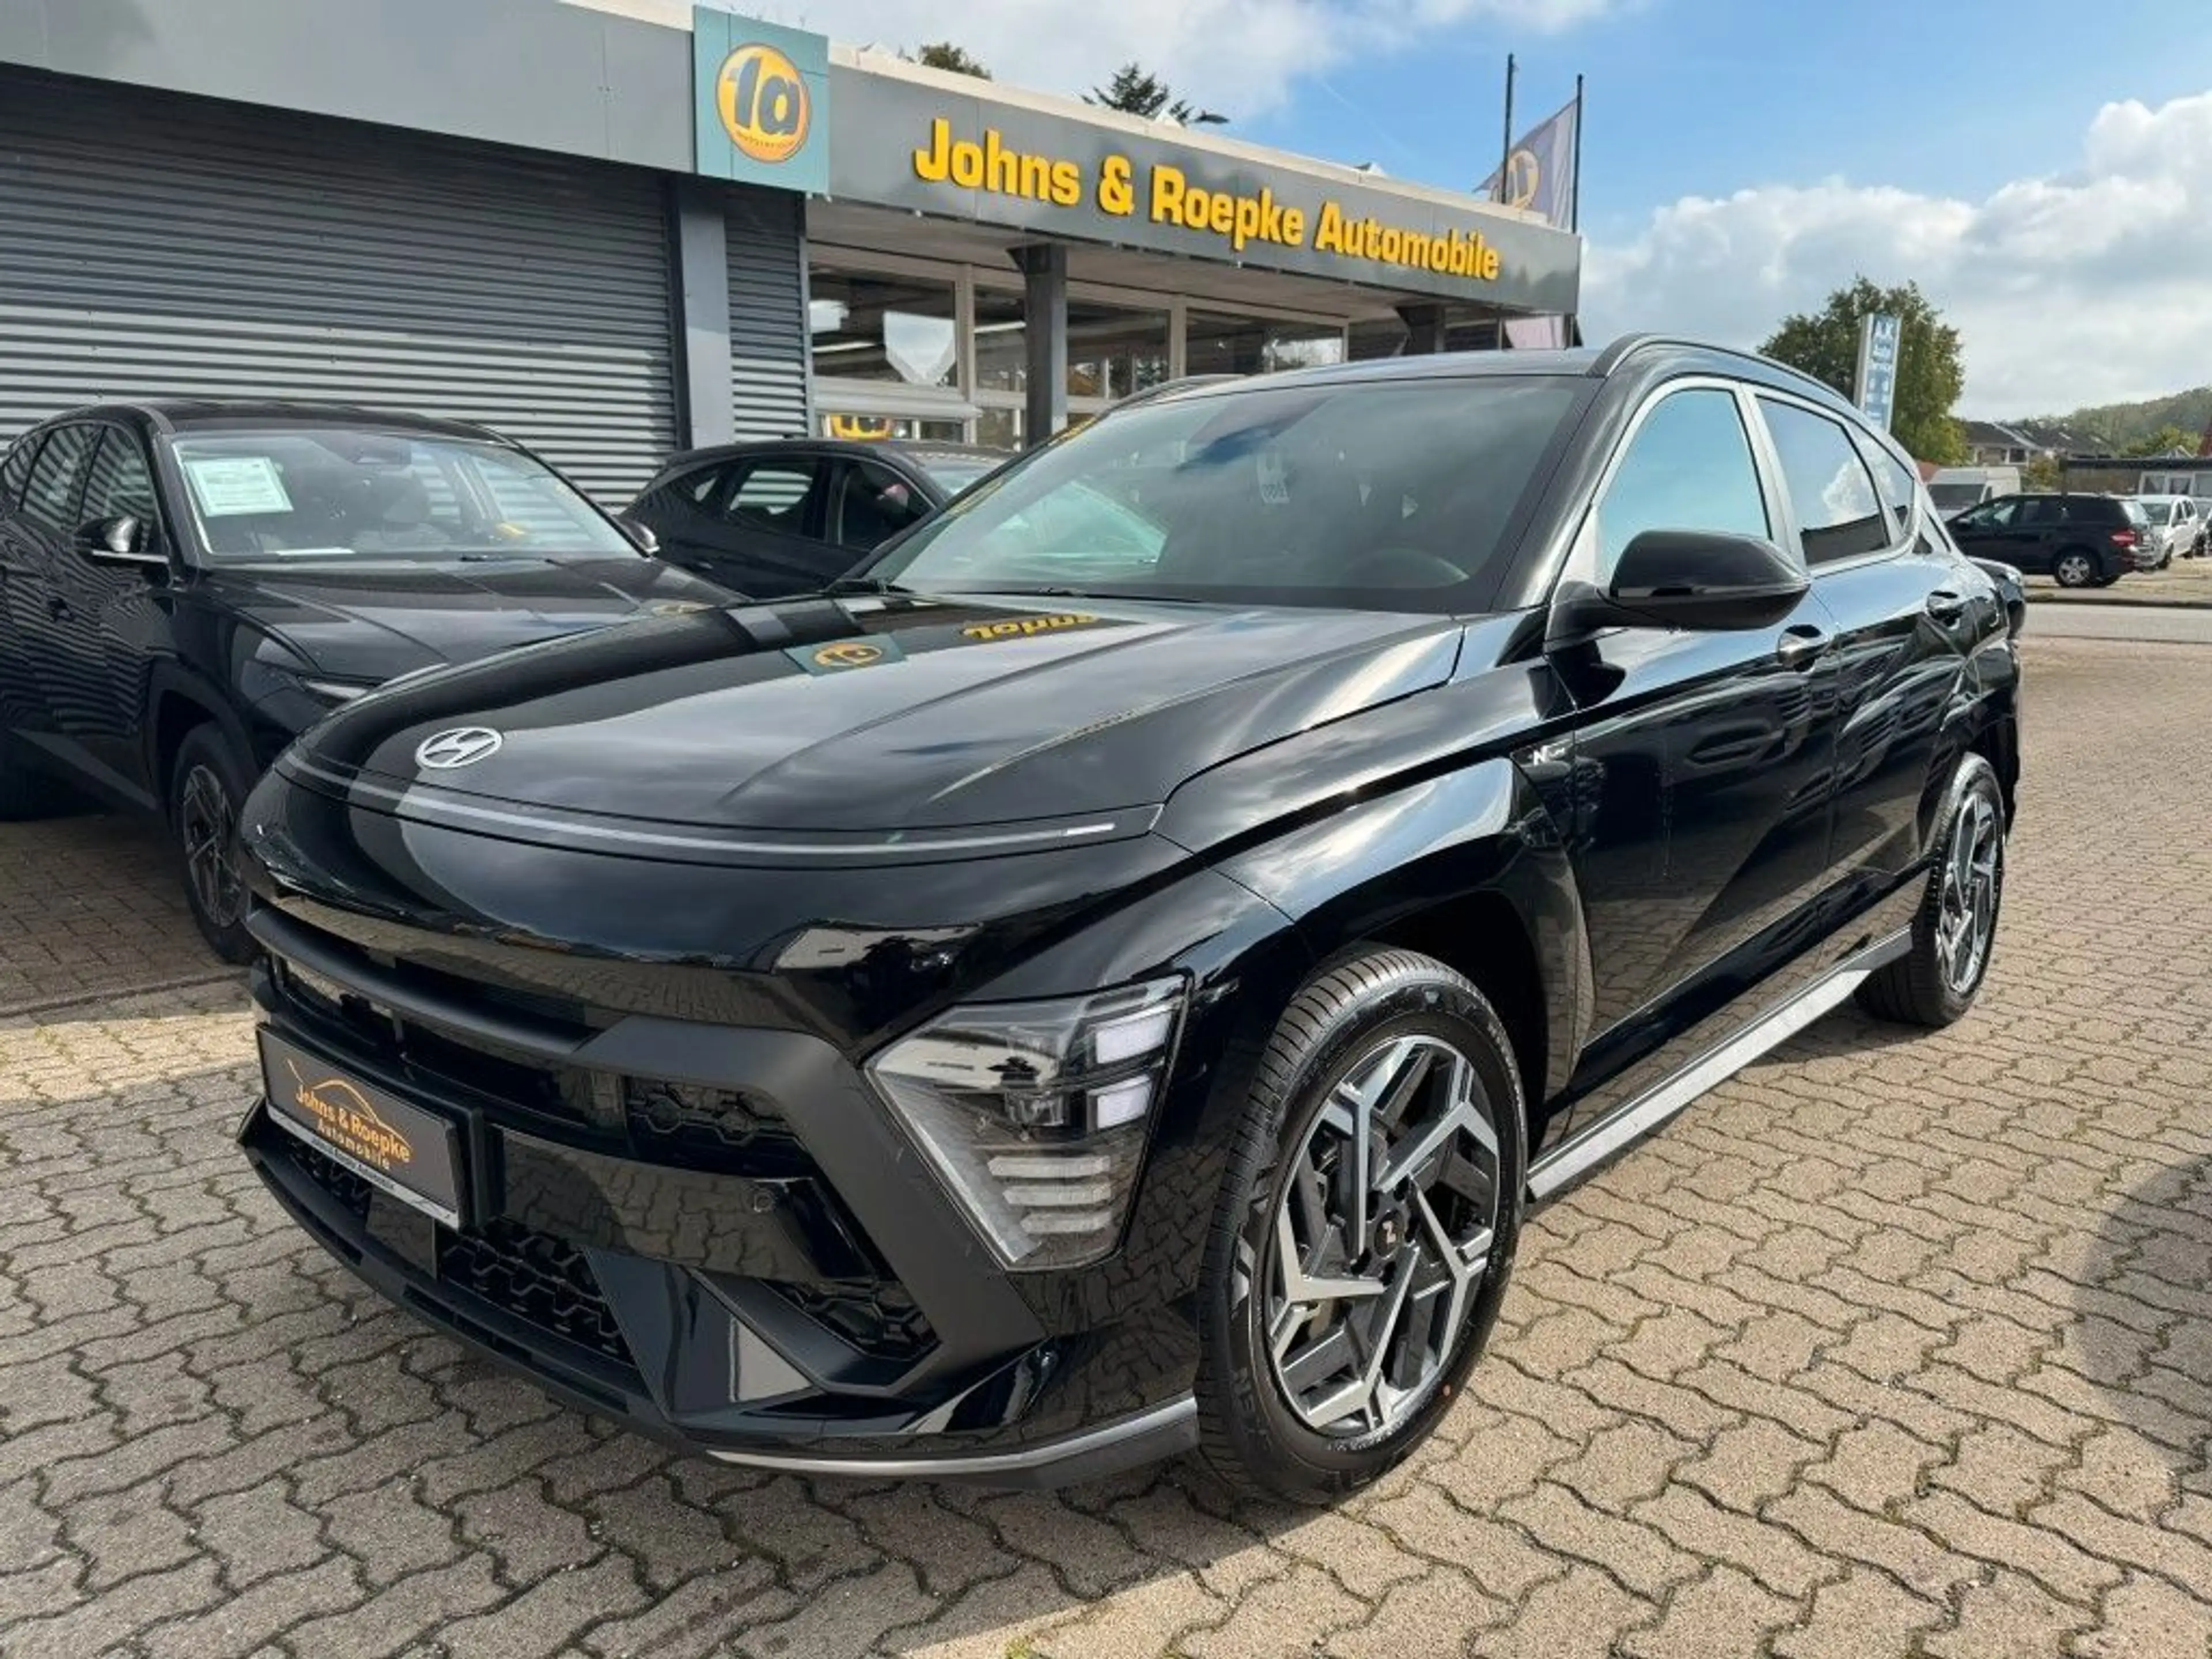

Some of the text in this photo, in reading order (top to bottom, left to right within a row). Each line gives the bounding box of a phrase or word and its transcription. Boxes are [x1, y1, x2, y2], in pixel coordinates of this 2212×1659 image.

[727, 57, 800, 135] 1a
[913, 118, 1499, 279] Johns & Roepke Automobile
[296, 1084, 336, 1122] Johns
[338, 1107, 349, 1129] &
[350, 1113, 410, 1163] Roepke
[317, 1118, 391, 1170] Automobile
